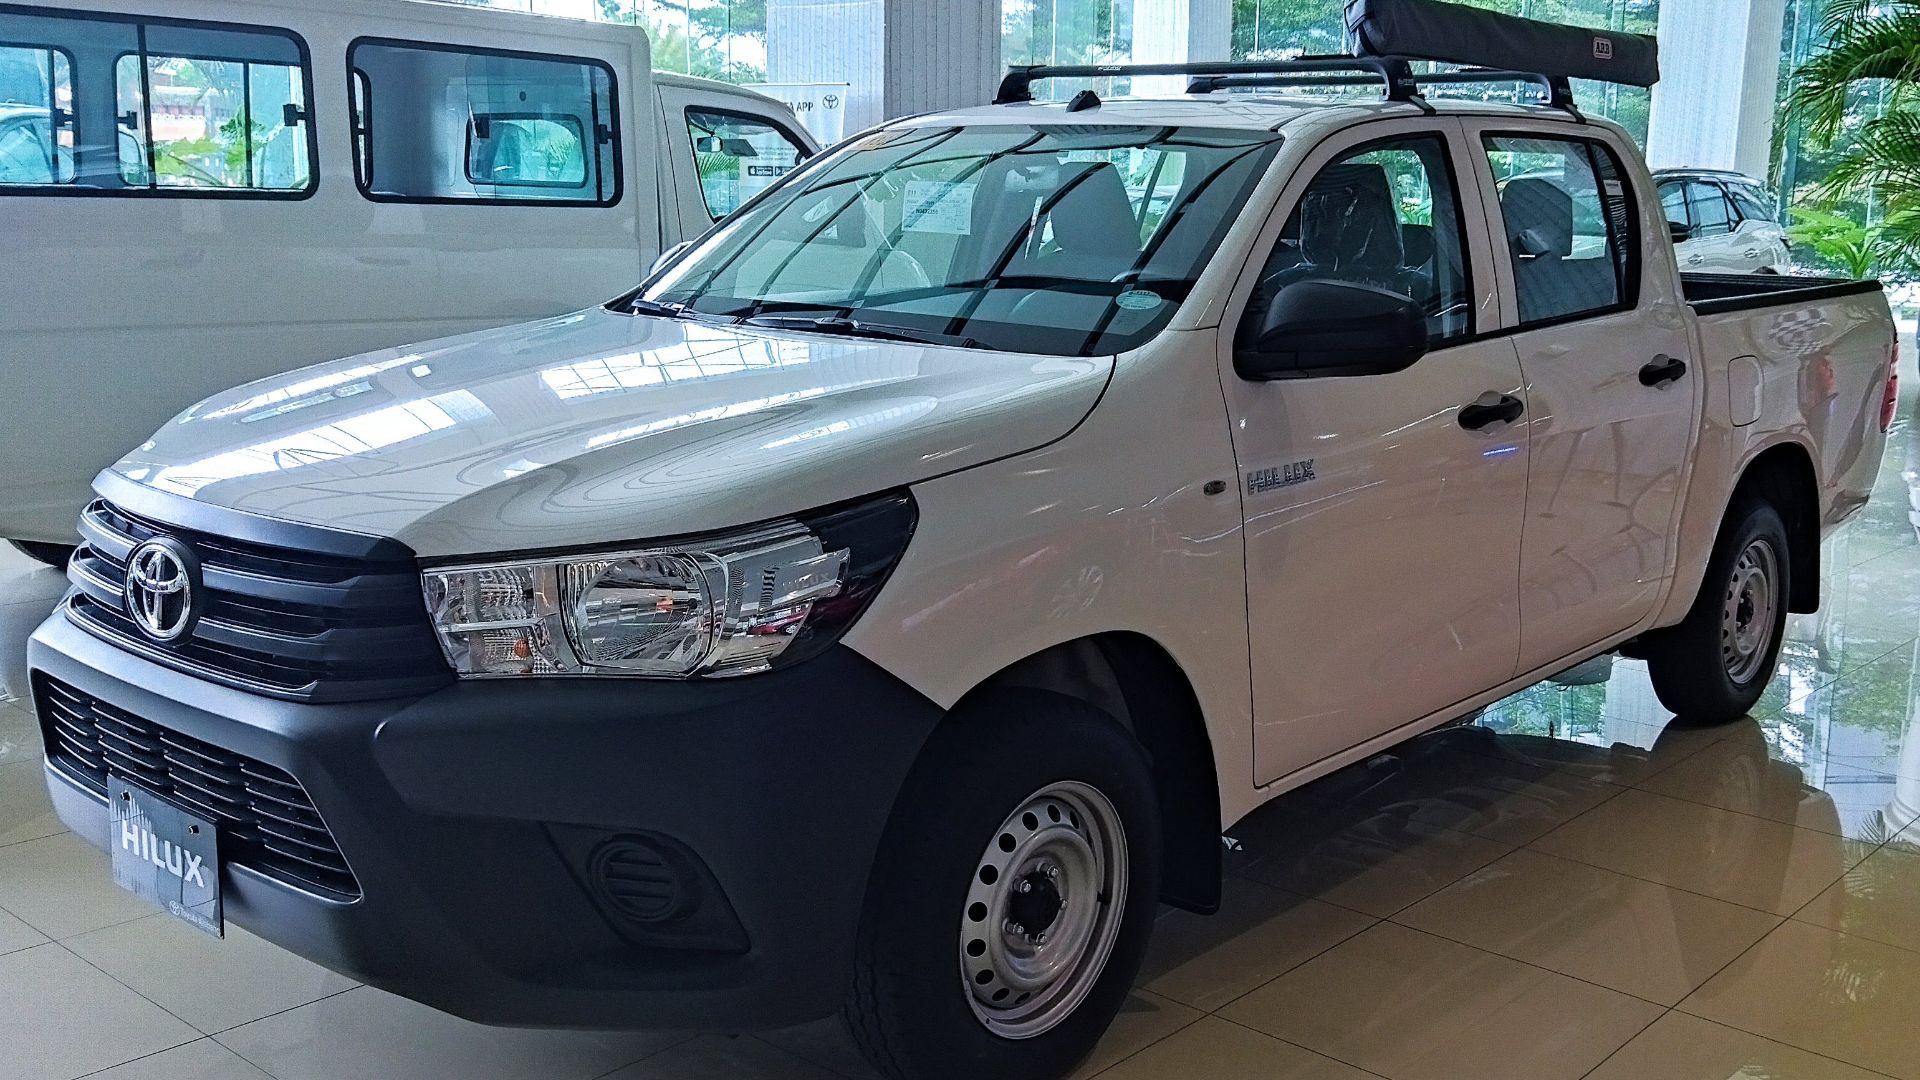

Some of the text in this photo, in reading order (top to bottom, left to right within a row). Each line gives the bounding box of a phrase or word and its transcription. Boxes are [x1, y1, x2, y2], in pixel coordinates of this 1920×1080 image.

[1595, 41, 1610, 55] ARB
[796, 101, 814, 112] APP
[1247, 458, 1316, 495] HILUX
[121, 818, 205, 888] HILUX
